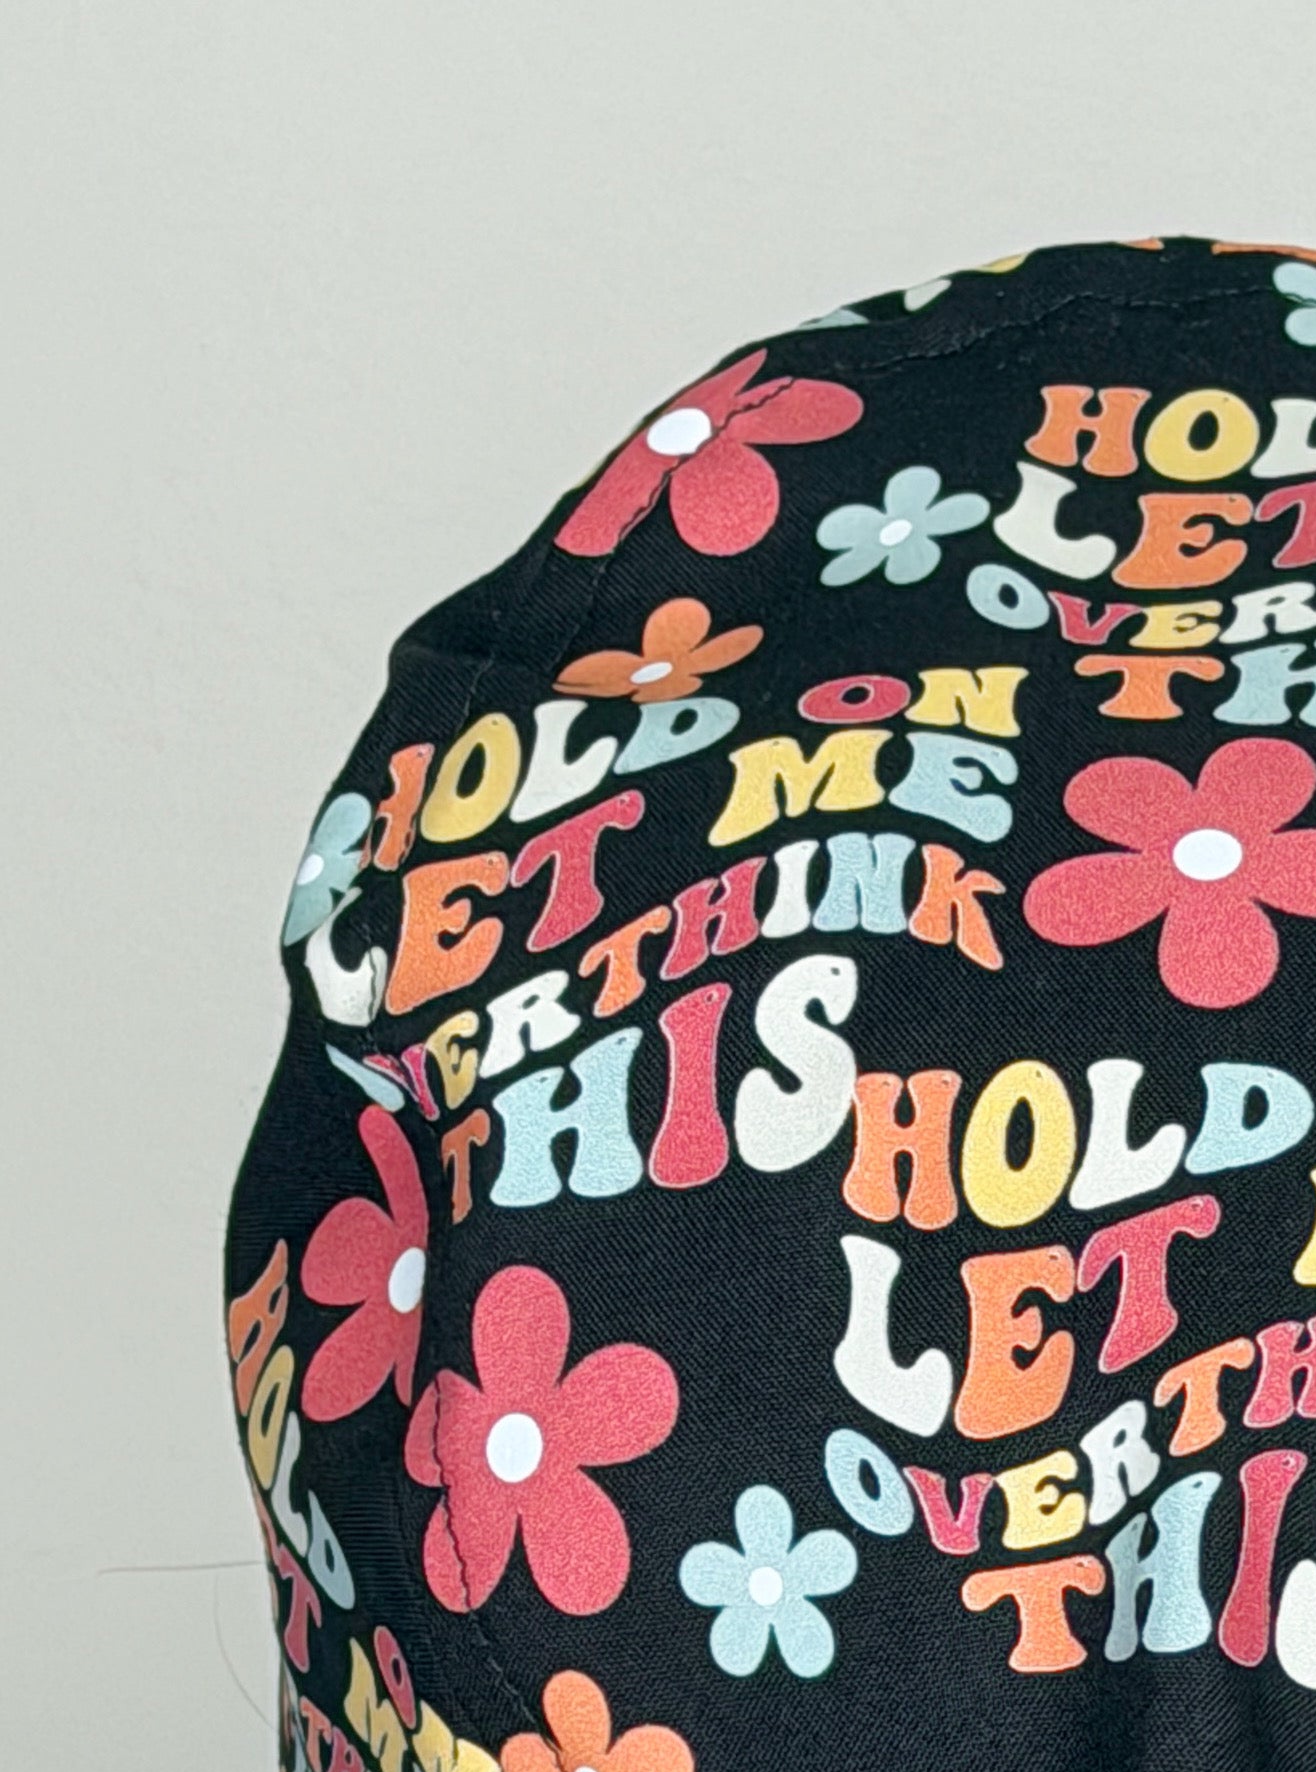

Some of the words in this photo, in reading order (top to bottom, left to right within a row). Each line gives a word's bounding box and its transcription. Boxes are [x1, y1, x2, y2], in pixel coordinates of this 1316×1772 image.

[305, 790, 645, 1026] LET
[708, 729, 1019, 843] ME
[358, 697, 740, 871] HOLD
[799, 667, 1028, 737] ON
[441, 954, 858, 1224] THIS
[842, 1059, 1314, 1230] HOLD
[228, 1238, 355, 1610] HOLD
[834, 1194, 1221, 1437] LET
